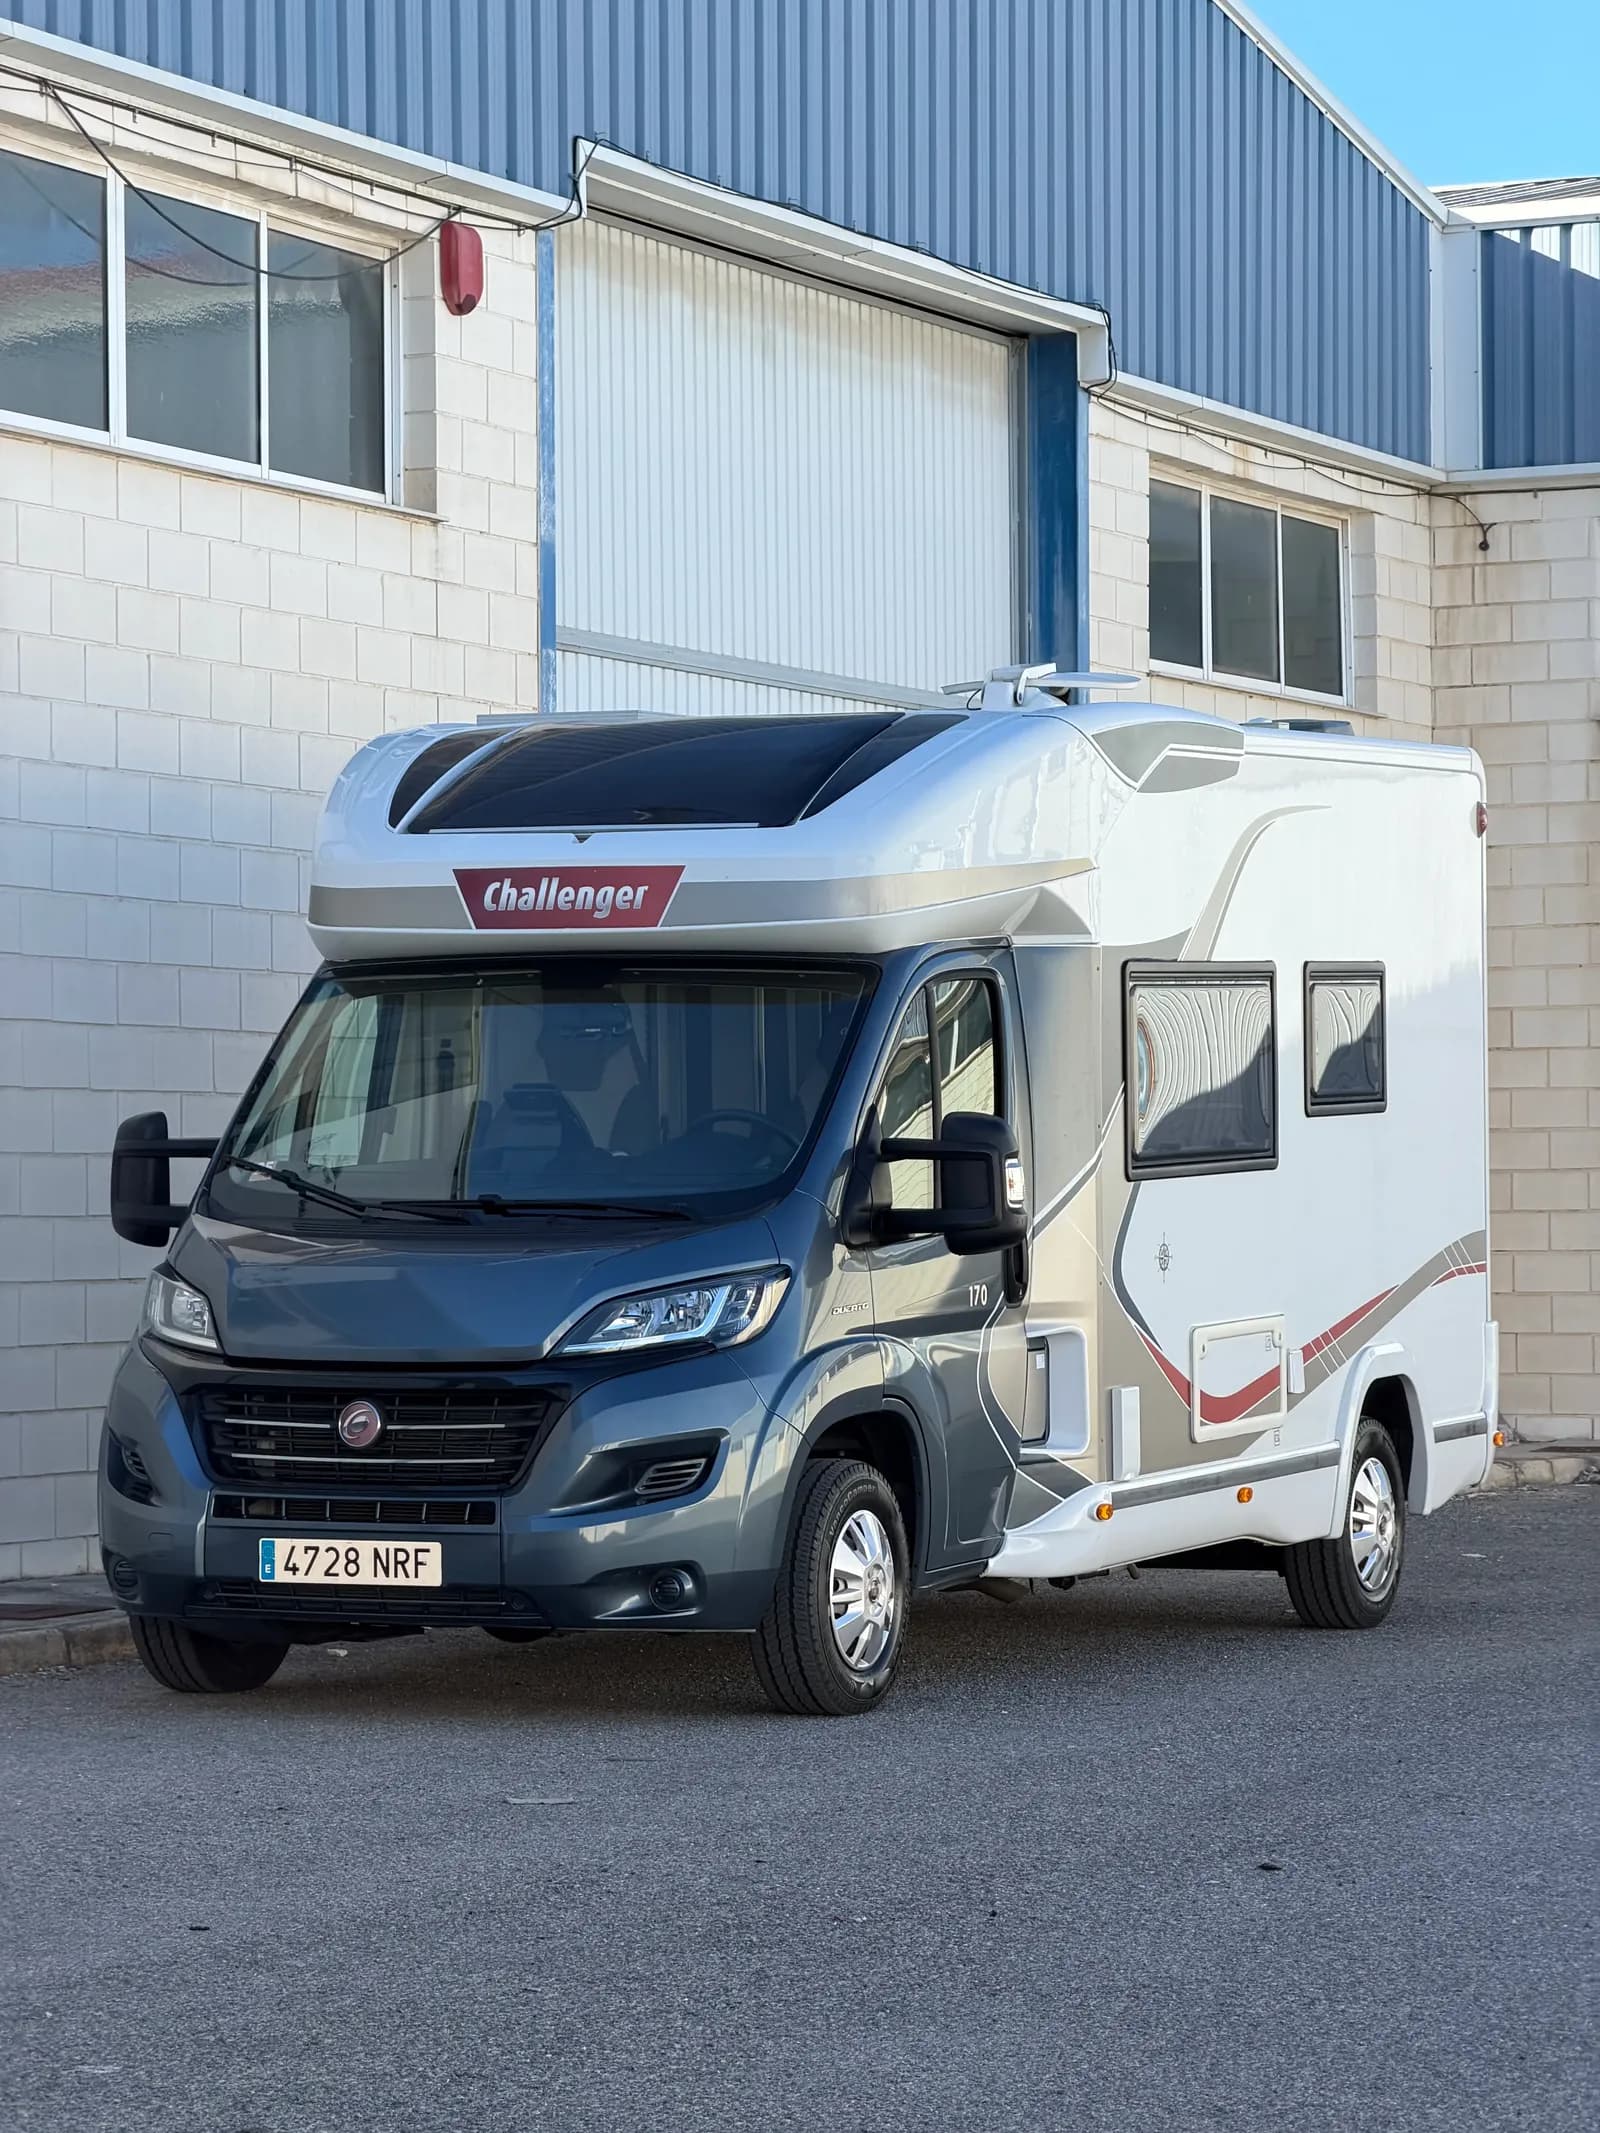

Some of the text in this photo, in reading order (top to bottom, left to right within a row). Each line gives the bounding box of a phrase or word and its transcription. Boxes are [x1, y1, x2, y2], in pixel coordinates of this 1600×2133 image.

[483, 876, 649, 919] Challenger
[968, 1283, 988, 1307] 170
[264, 1563, 272, 1574] E
[283, 1545, 431, 1579] 4728 NRF
